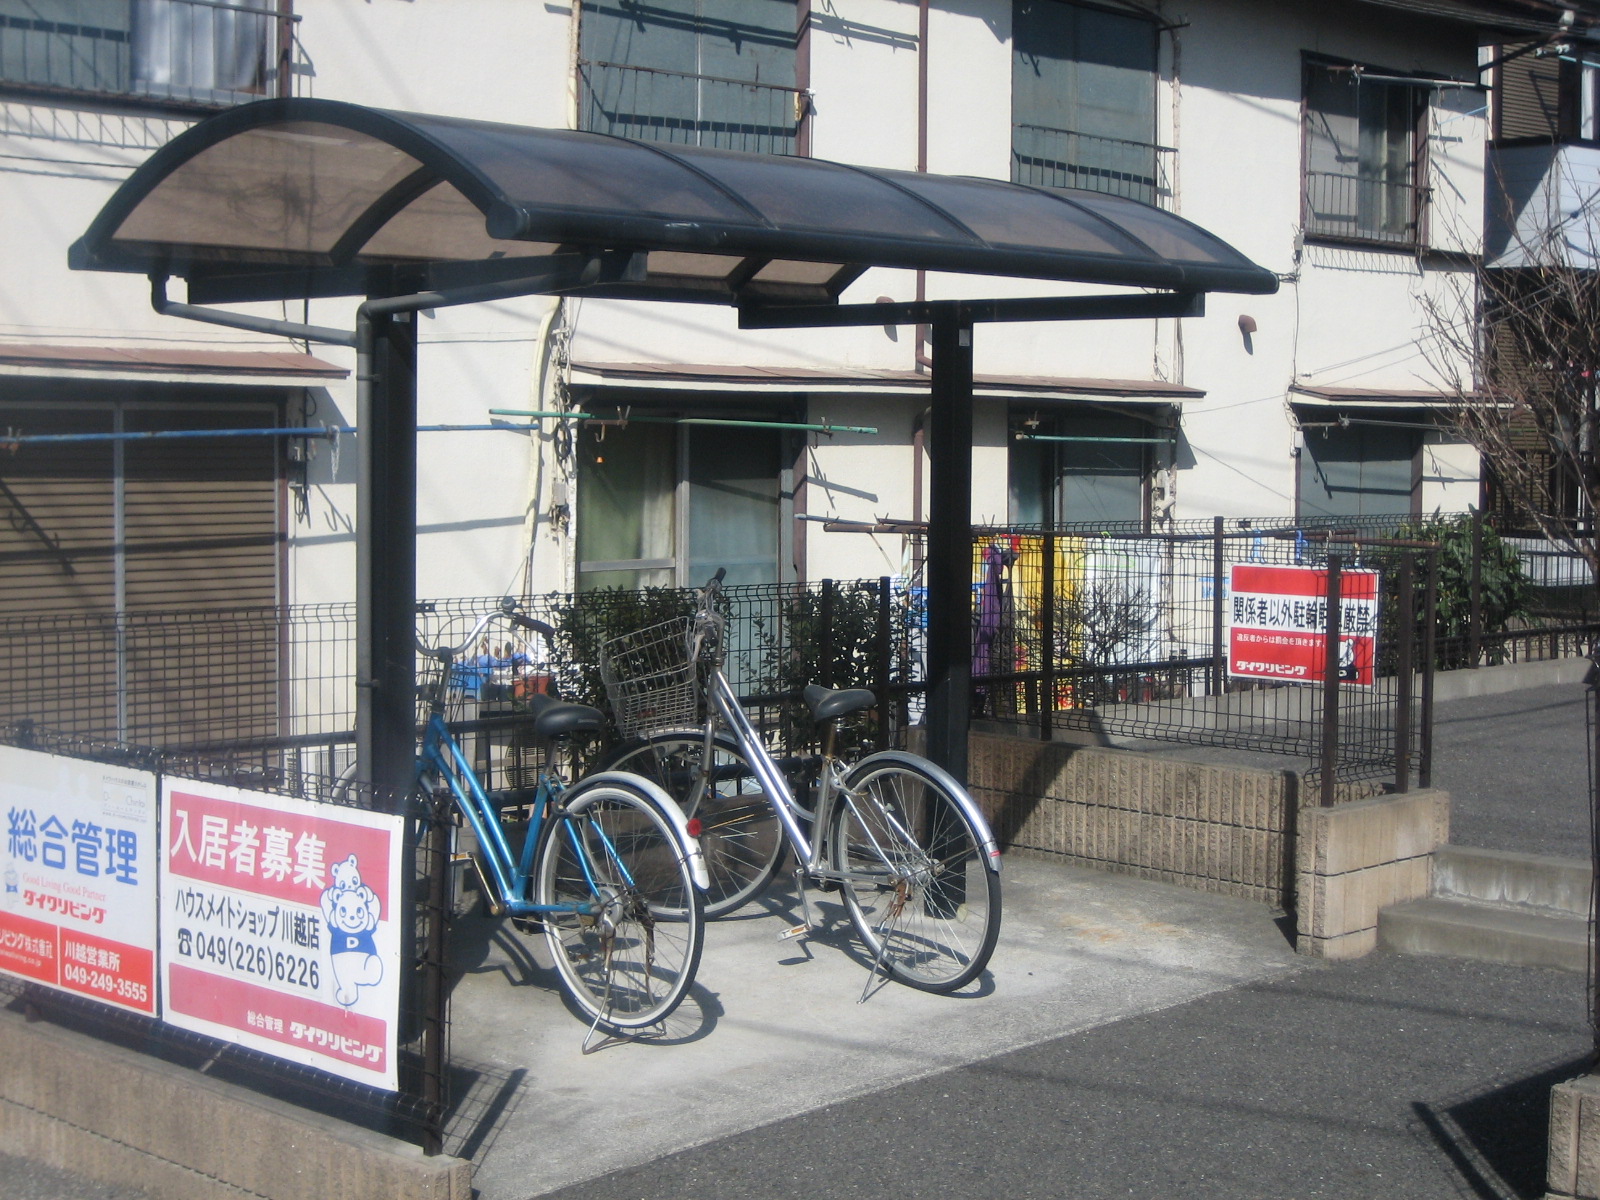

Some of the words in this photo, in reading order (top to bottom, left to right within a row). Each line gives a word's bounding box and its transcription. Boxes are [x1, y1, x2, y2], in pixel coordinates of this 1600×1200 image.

[1236, 660, 1307, 676] ダイワリビング
[7, 806, 138, 886] 総合管理
[171, 809, 327, 890] 入居者募集
[23, 890, 107, 924] ダイワリビング
[65, 940, 120, 972] 川越営業所
[196, 931, 320, 990] 049(226)6226
[65, 964, 147, 1003] 049-249-3555
[247, 1010, 284, 1034] 総合管理
[290, 1021, 383, 1063] ダイワリビング
